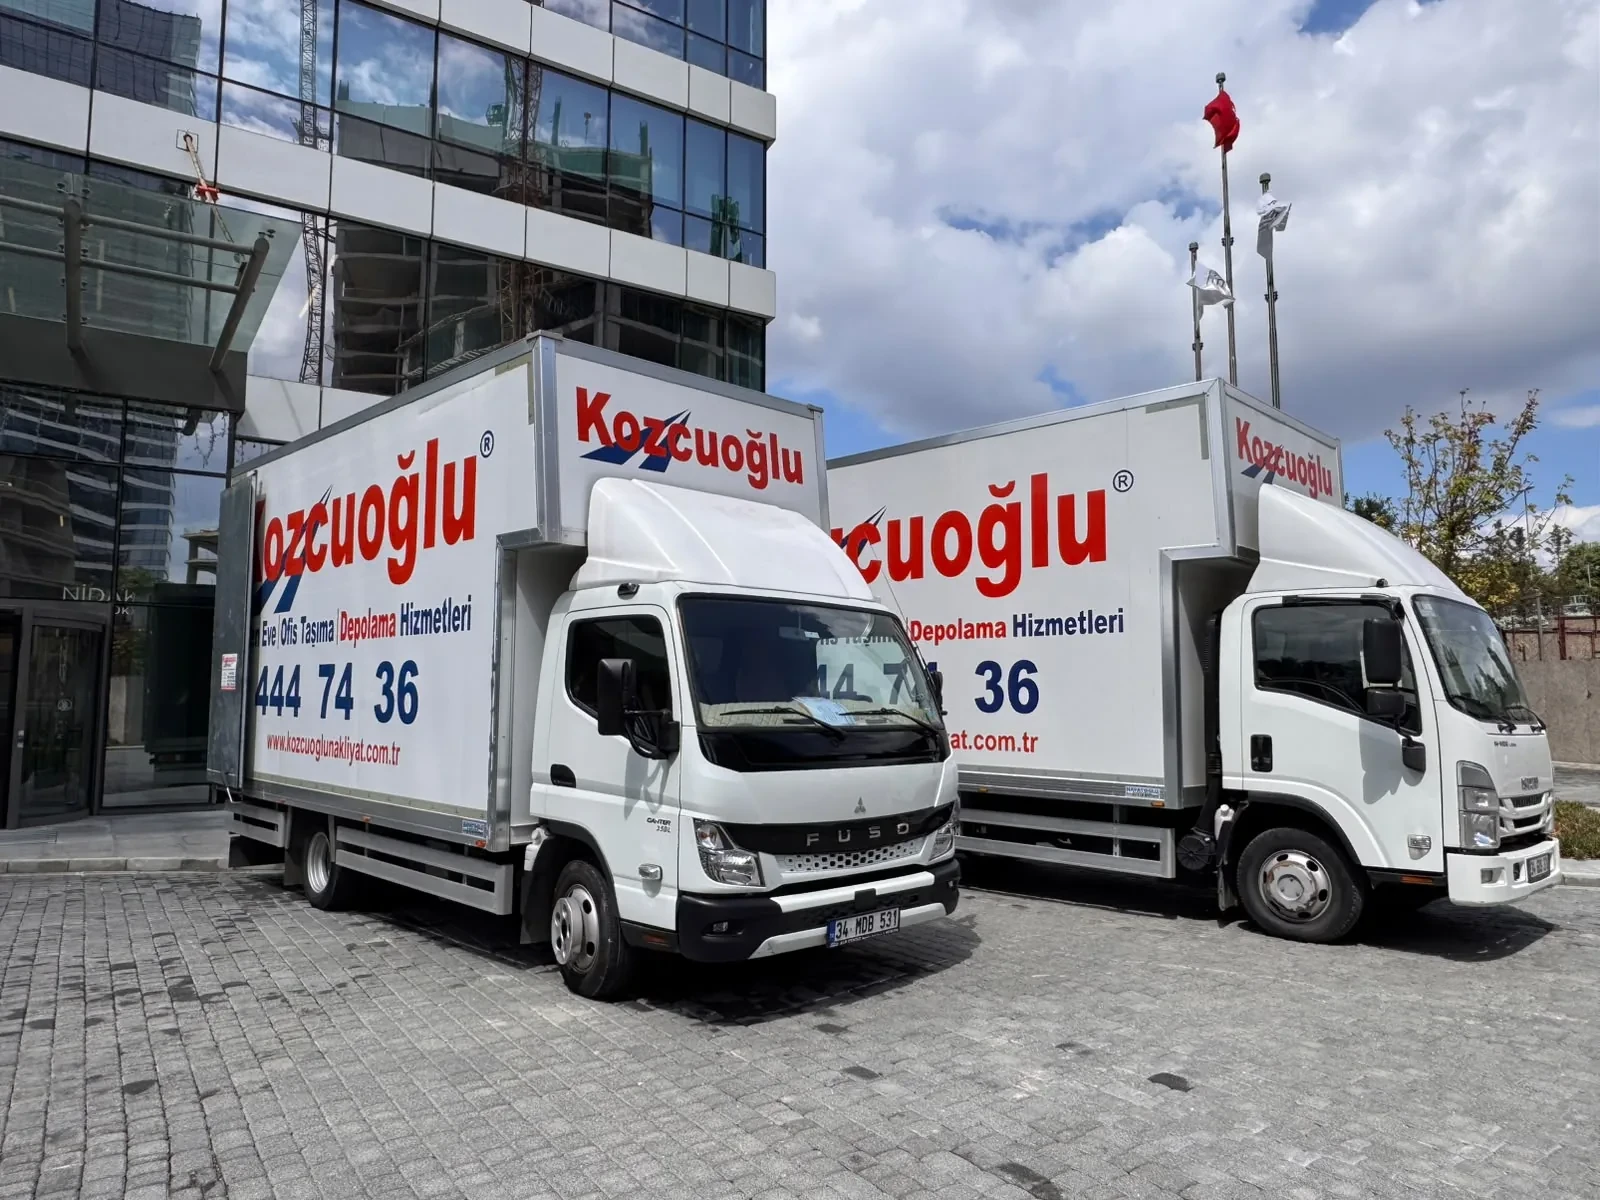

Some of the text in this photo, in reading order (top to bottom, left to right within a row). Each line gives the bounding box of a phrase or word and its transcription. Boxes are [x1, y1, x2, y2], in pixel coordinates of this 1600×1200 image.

[576, 386, 804, 490] Kozcuoğlu
[1236, 416, 1333, 500] Kozcuoğlu
[831, 473, 1107, 598] cuoğlu
[261, 620, 277, 647] Eve
[281, 617, 298, 646] Ofis
[301, 616, 334, 647] Taşıma
[340, 608, 396, 648] Depolama
[400, 594, 472, 637] Hizmetleri
[910, 608, 1124, 646] Depolama Hizmetleri
[255, 664, 301, 718] 444
[318, 662, 354, 720] 74
[374, 660, 419, 725] 36
[974, 659, 1039, 714] 36
[266, 731, 401, 766] www.kozcuoglunakliyat.com.tr
[806, 823, 909, 846] FUSO
[836, 921, 848, 939] 34
[855, 915, 874, 935] MDB
[880, 910, 897, 929] 531
